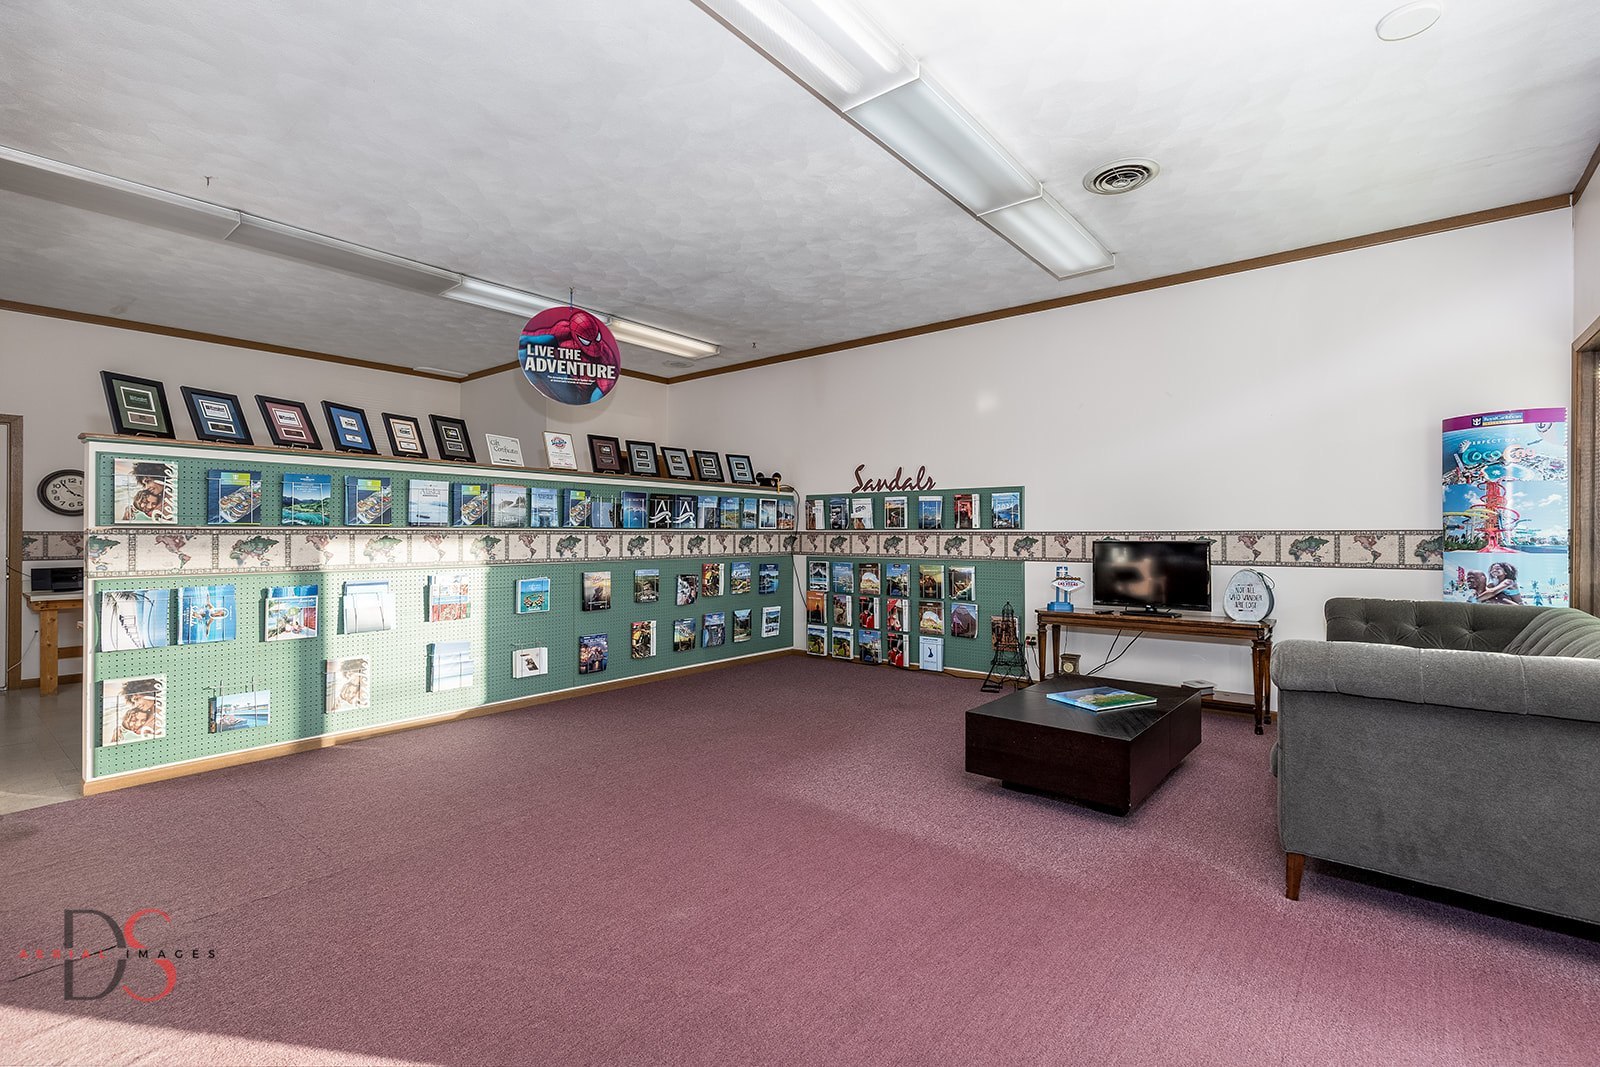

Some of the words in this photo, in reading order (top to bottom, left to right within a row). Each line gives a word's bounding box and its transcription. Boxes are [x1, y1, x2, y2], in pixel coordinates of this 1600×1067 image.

[527, 344, 554, 357] LIVE
[557, 348, 582, 361] THE
[525, 356, 616, 379] ADVENTURE
[851, 464, 936, 494] Sandals
